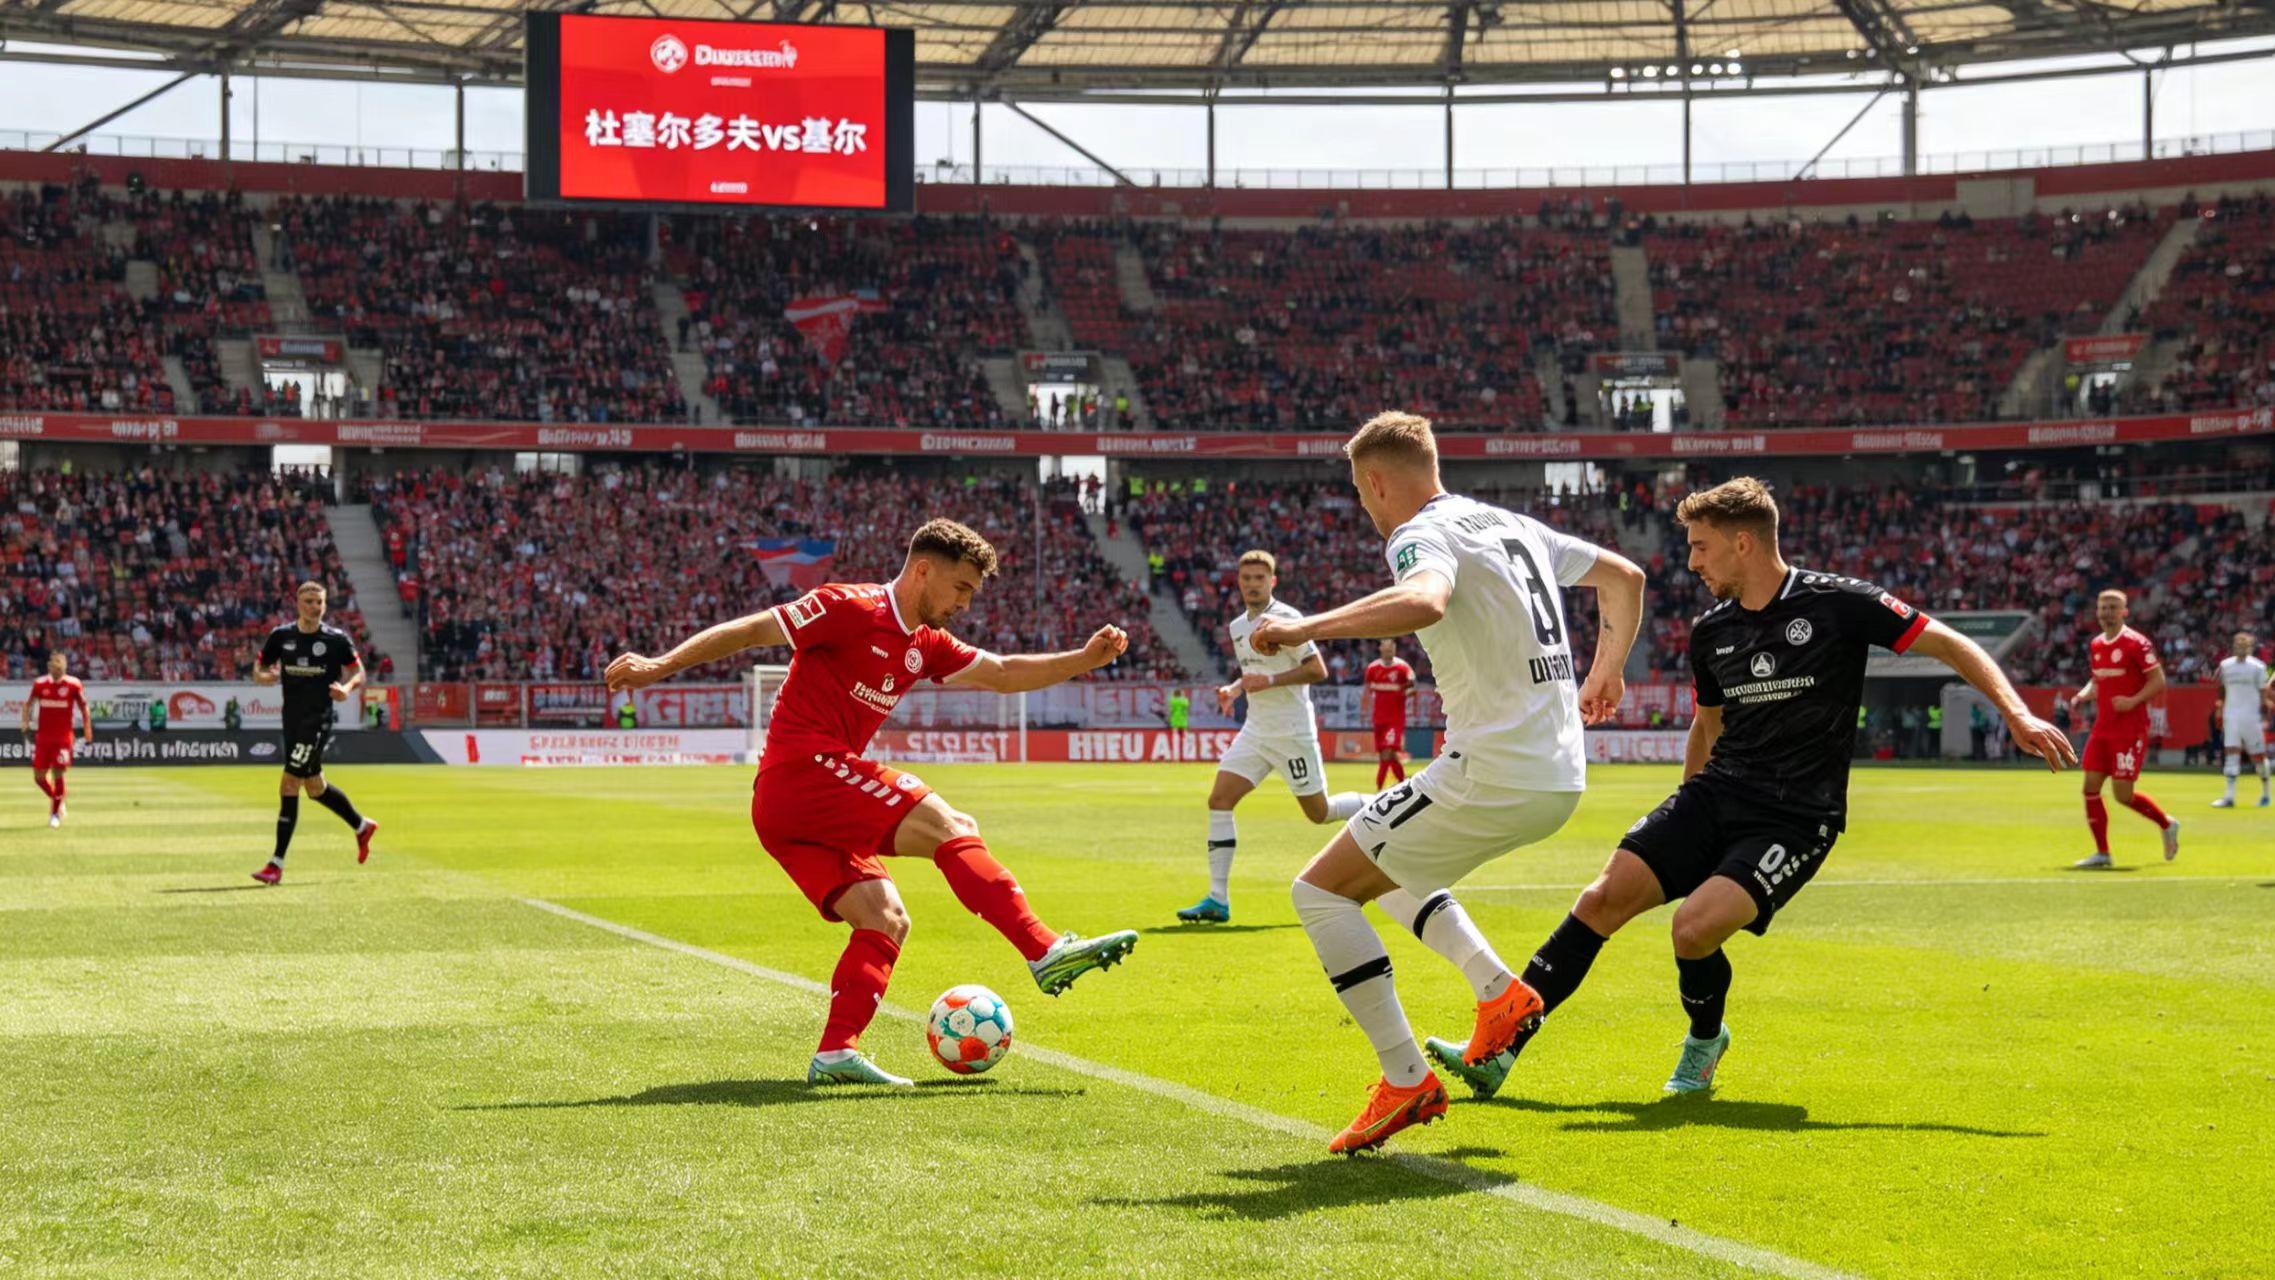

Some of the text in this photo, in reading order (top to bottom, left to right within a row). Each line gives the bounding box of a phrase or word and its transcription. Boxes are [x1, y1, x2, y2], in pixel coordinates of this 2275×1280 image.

[585, 109, 867, 155] 杜塞尔多夫vs基尔
